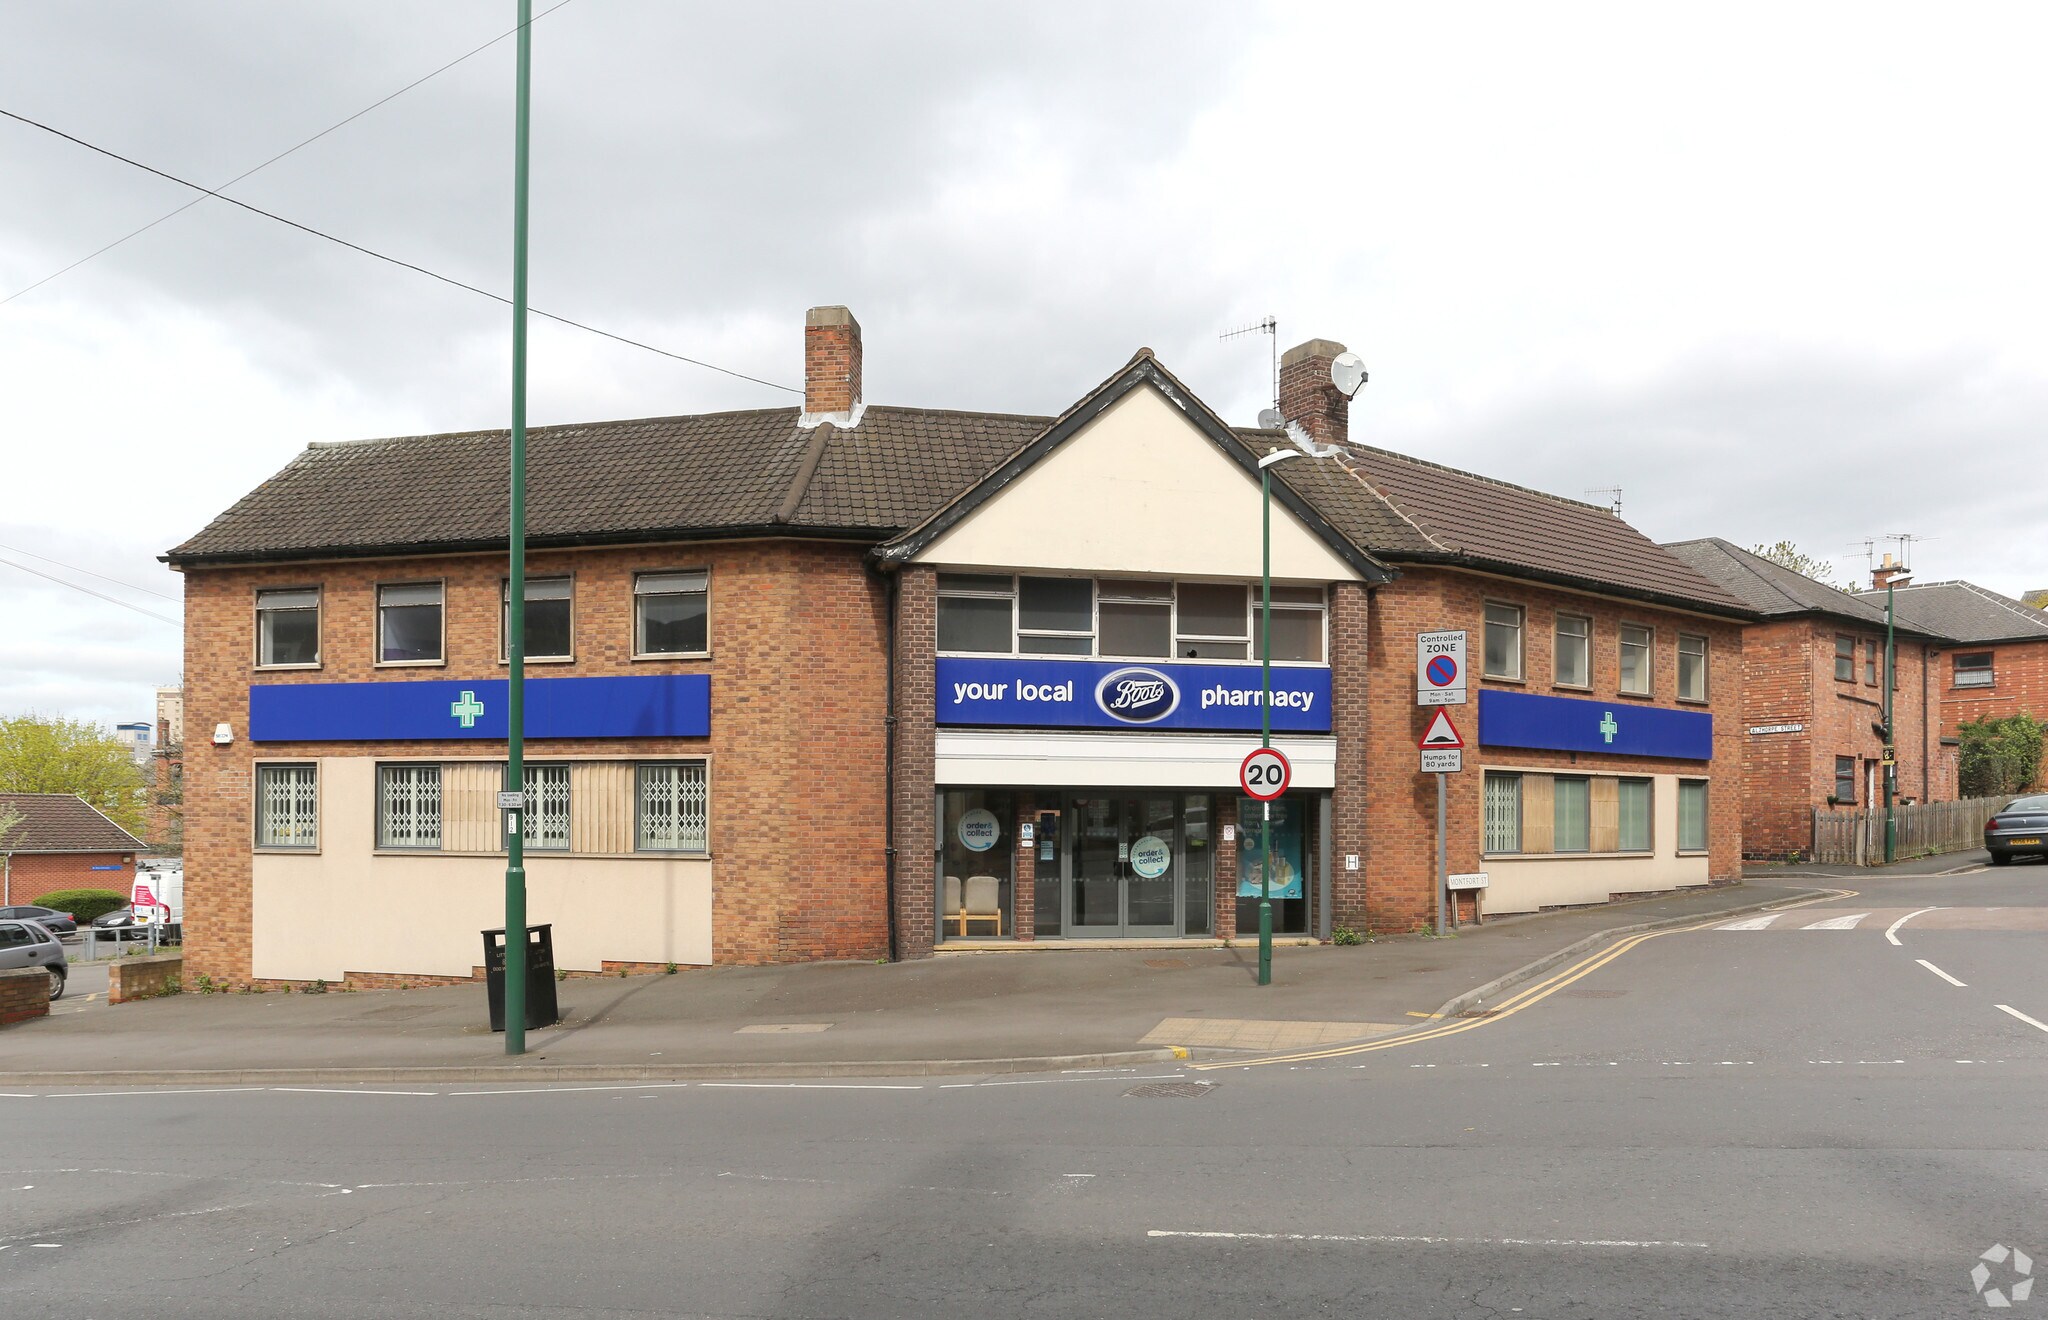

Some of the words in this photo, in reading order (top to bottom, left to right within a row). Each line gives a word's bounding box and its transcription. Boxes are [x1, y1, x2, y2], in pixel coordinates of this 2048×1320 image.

[1420, 634, 1463, 643] Controlled
[1426, 643, 1456, 653] ZONE
[953, 682, 1008, 704] your
[1016, 678, 1073, 702] local
[1110, 679, 1165, 709] Boots
[1201, 684, 1314, 712] pharmacy
[1437, 760, 1456, 768] yards
[1248, 764, 1283, 786] 20
[966, 829, 993, 837] collect
[1138, 855, 1164, 864] collect
[1347, 855, 1357, 868] H
